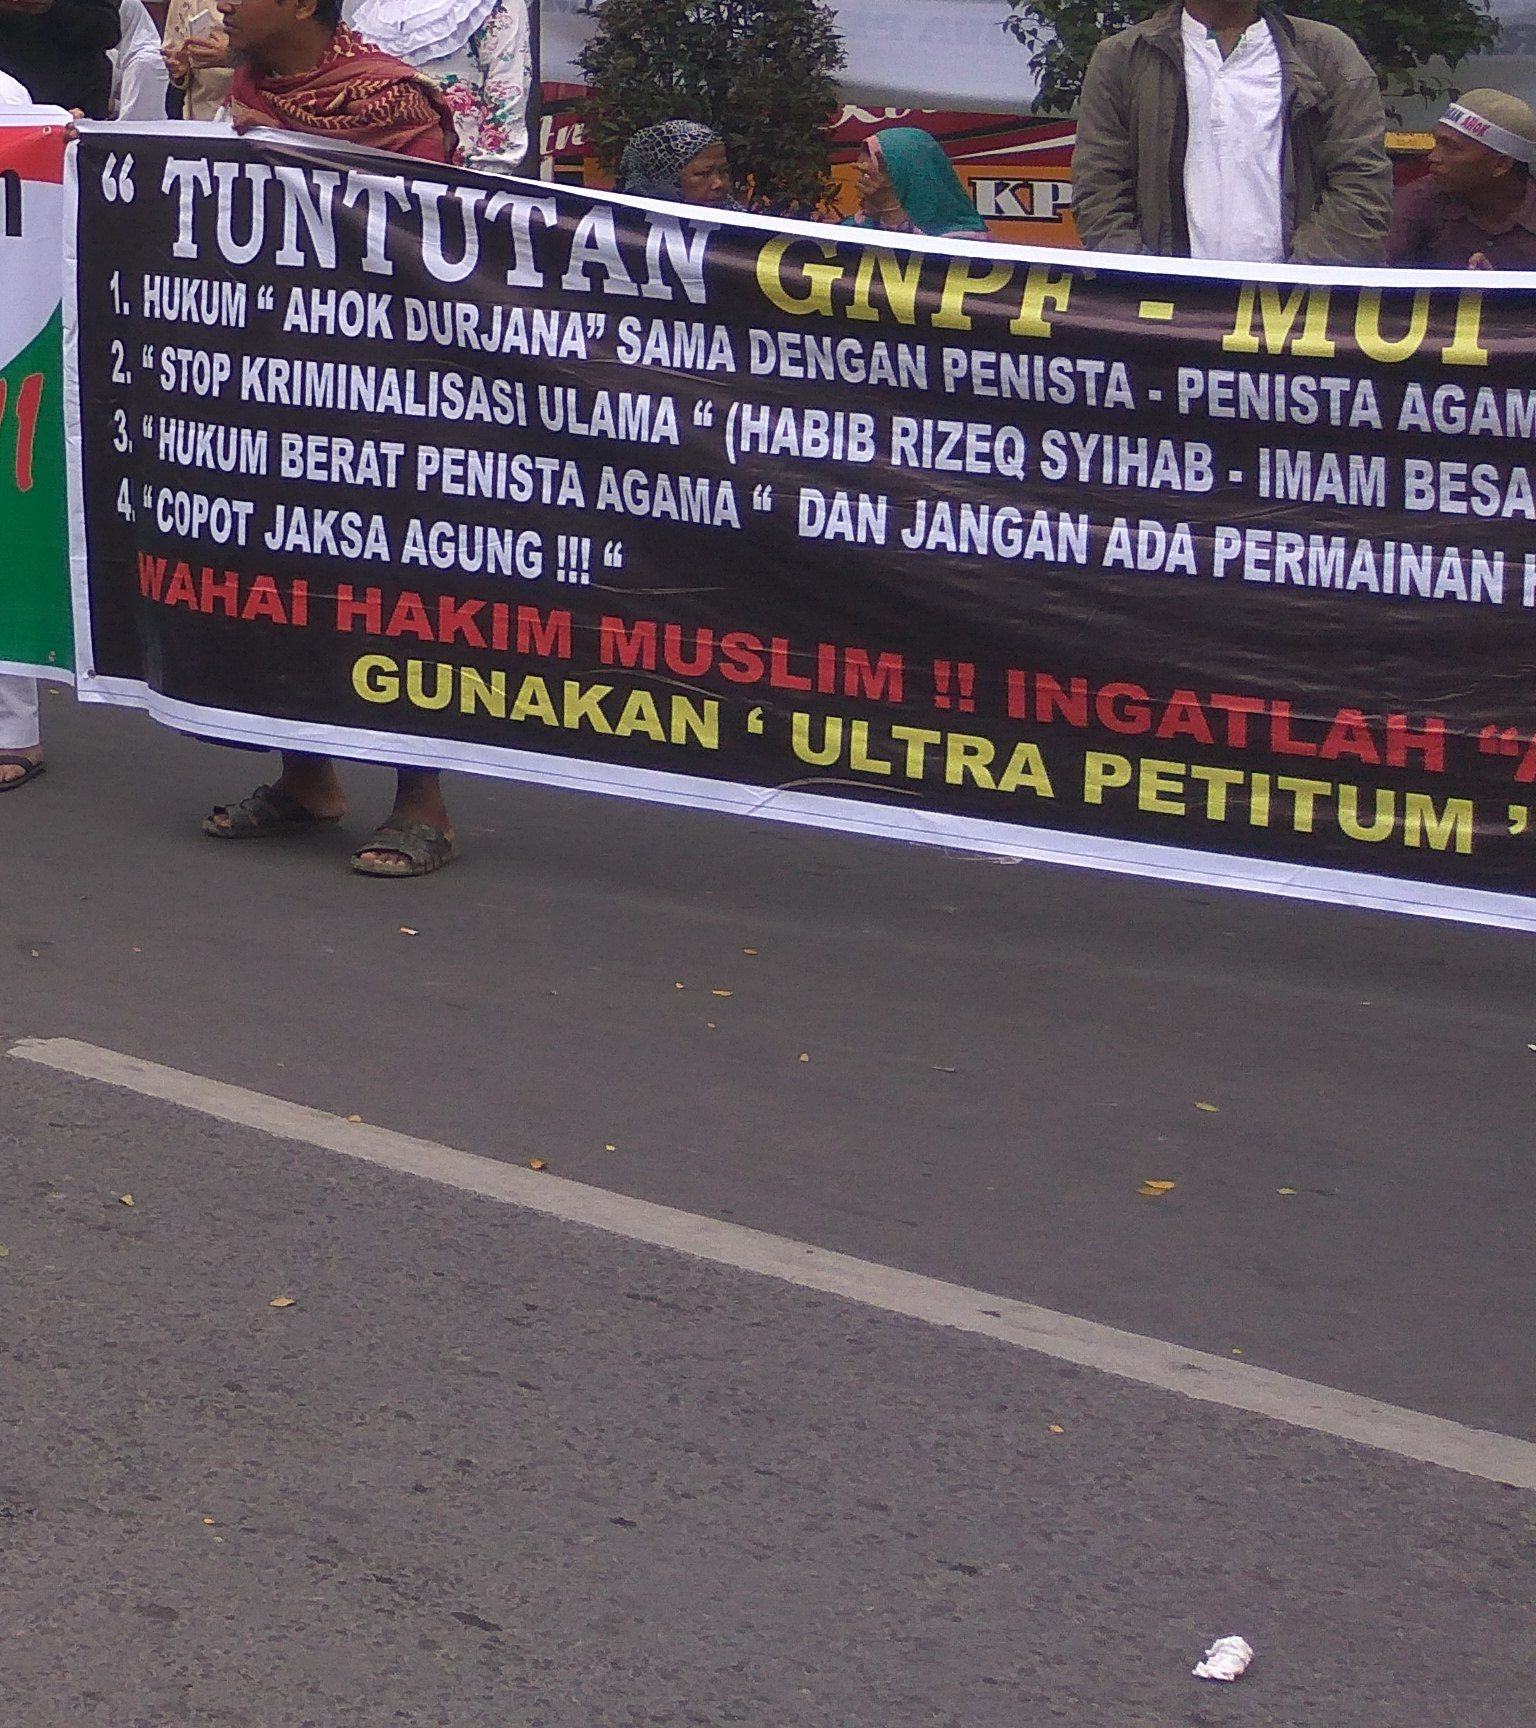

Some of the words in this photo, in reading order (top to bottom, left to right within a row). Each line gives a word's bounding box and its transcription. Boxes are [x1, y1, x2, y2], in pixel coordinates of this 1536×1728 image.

[161, 156, 722, 305] TUNTUTAN
[754, 230, 1094, 340] GNPF
[1221, 278, 1493, 367] MUI
[142, 273, 248, 329] HUKUM
[283, 287, 392, 341] AHOK
[616, 316, 735, 374] SAMA
[749, 328, 928, 391] DENGAN
[942, 346, 1134, 411] PENISTA
[1177, 365, 1382, 430] PENISTA
[240, 355, 527, 428] KRIMINALISASI
[538, 383, 680, 446] ULAMA
[725, 400, 877, 465] (HABIB
[890, 415, 1026, 481] RIZEQ
[1040, 429, 1214, 492] SYIHAB
[1258, 446, 1386, 508] IMAM
[264, 501, 391, 563] JAKSA
[401, 520, 544, 582] AGUNG
[280, 432, 406, 484] BERAT
[417, 450, 586, 509] PENISTA
[596, 469, 741, 530] AGAMA
[797, 487, 888, 546] DAN
[901, 503, 1090, 566] JANGAN
[1101, 520, 1199, 576] ADA
[1213, 526, 1505, 607] PERMAINAN
[137, 550, 309, 627] WAHAI
[336, 583, 573, 660] HAKIM
[600, 614, 905, 705] MUSLIM
[1007, 668, 1446, 773] INGATLAH
[350, 652, 720, 751] GUNAKAN
[791, 709, 1056, 799] ULTRA
[1082, 749, 1475, 856] PETITUM
